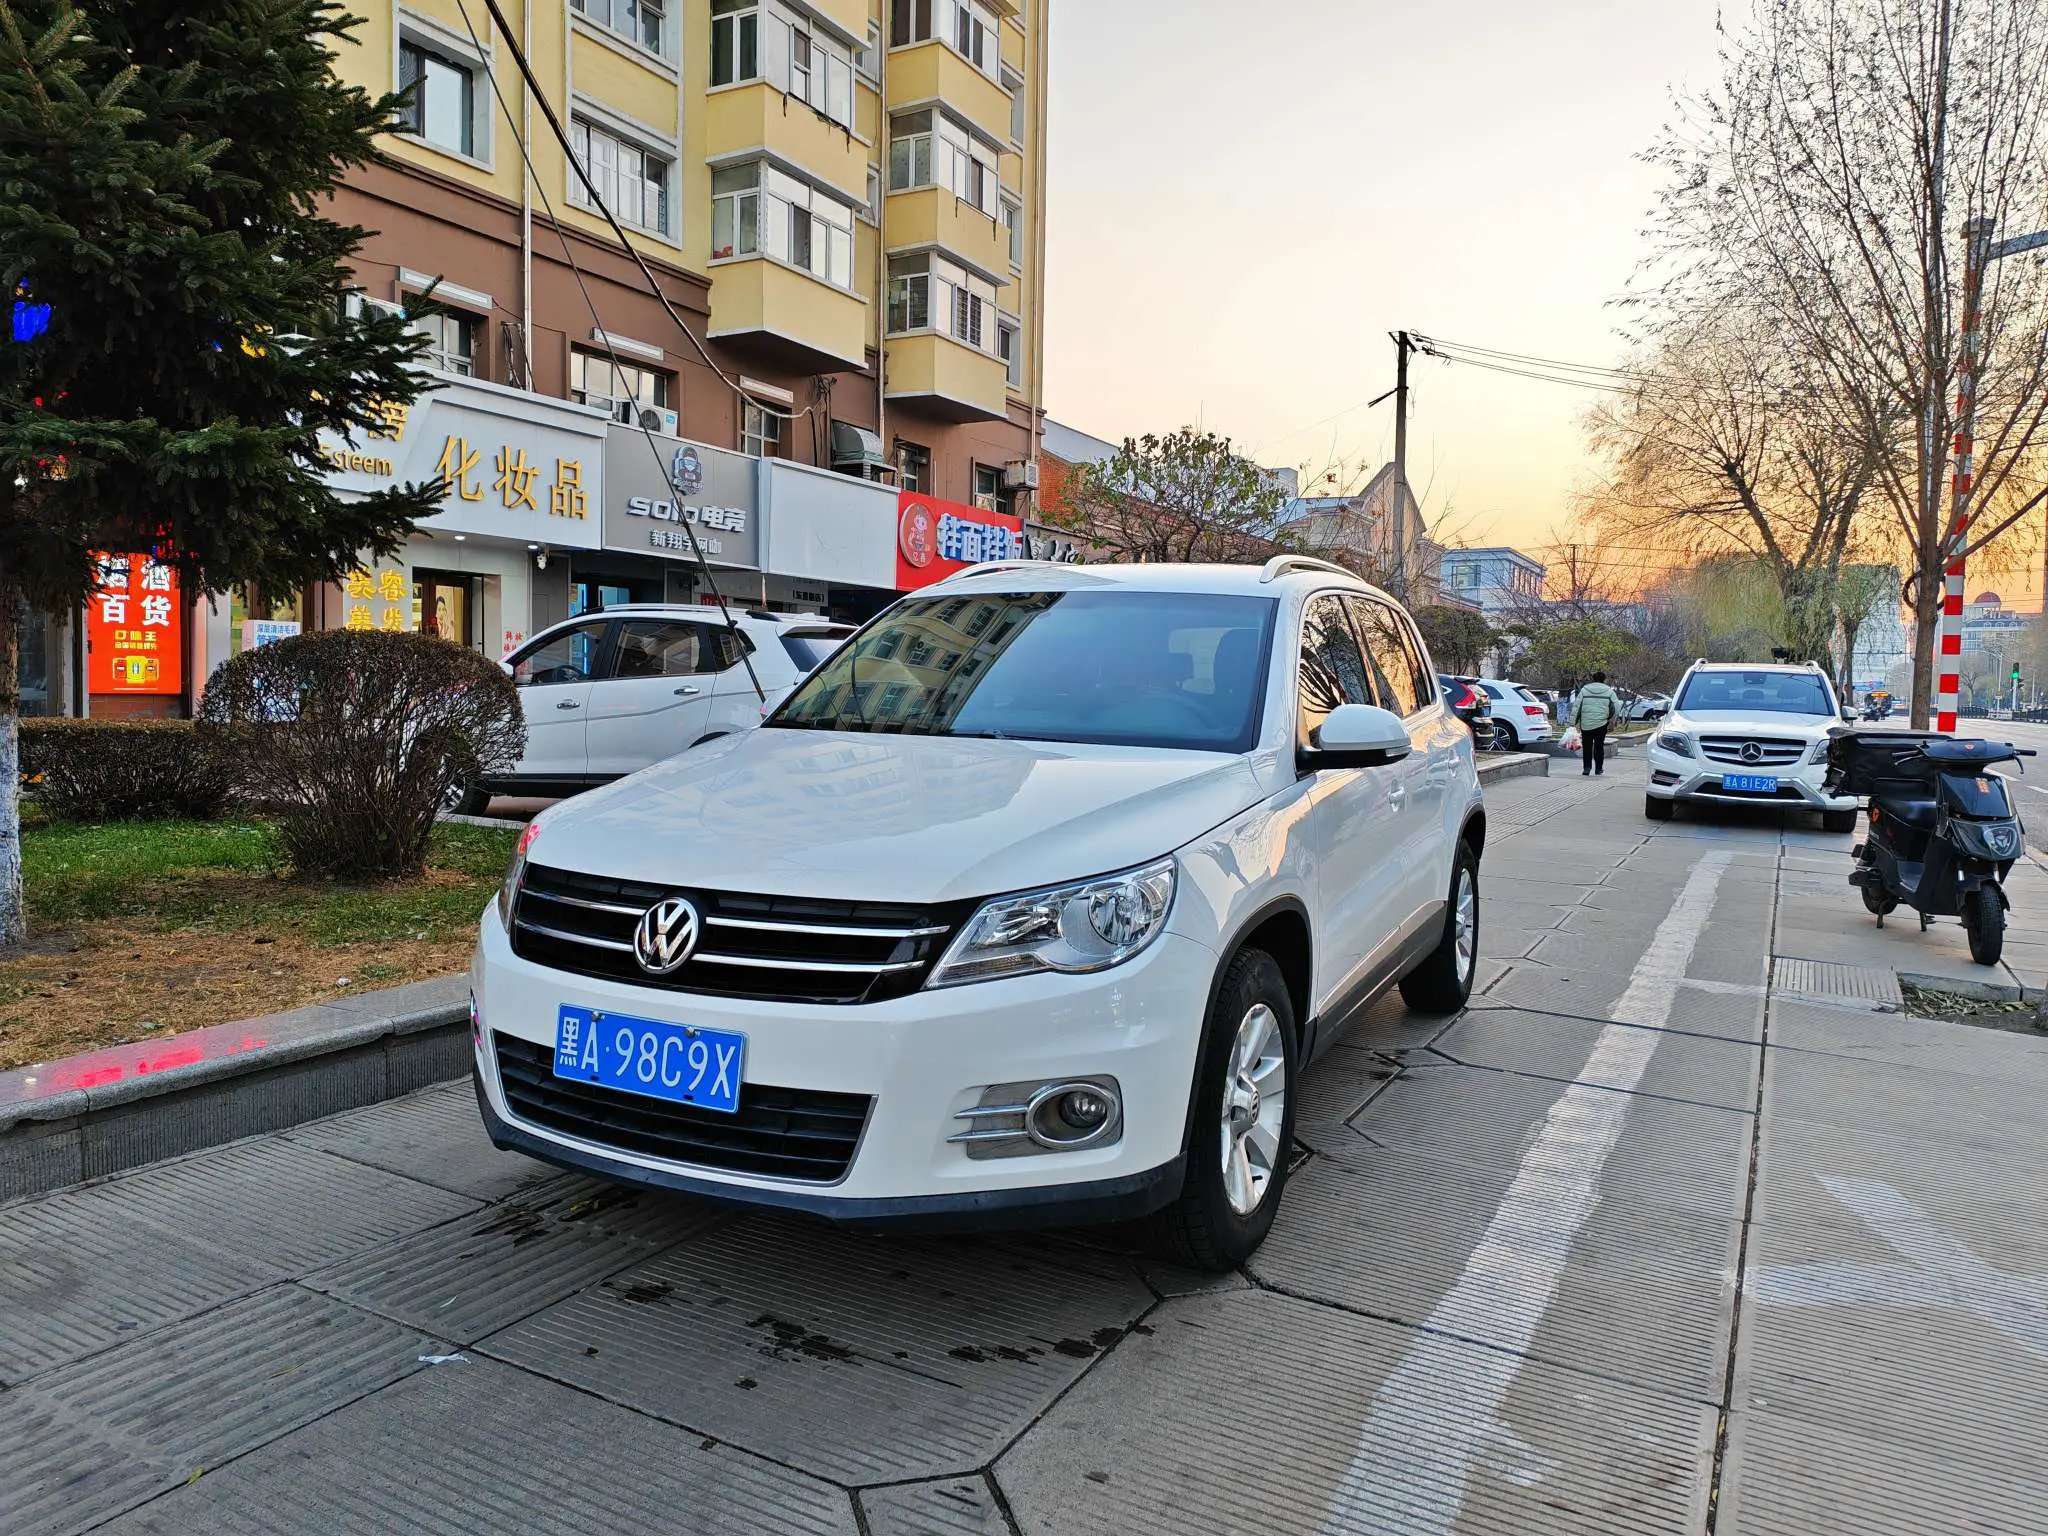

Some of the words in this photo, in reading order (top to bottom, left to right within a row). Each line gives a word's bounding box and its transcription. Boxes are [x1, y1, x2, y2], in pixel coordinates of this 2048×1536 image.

[434, 433, 588, 521] 化妆品
[700, 504, 747, 533] 电竞
[96, 593, 172, 627] 百货
